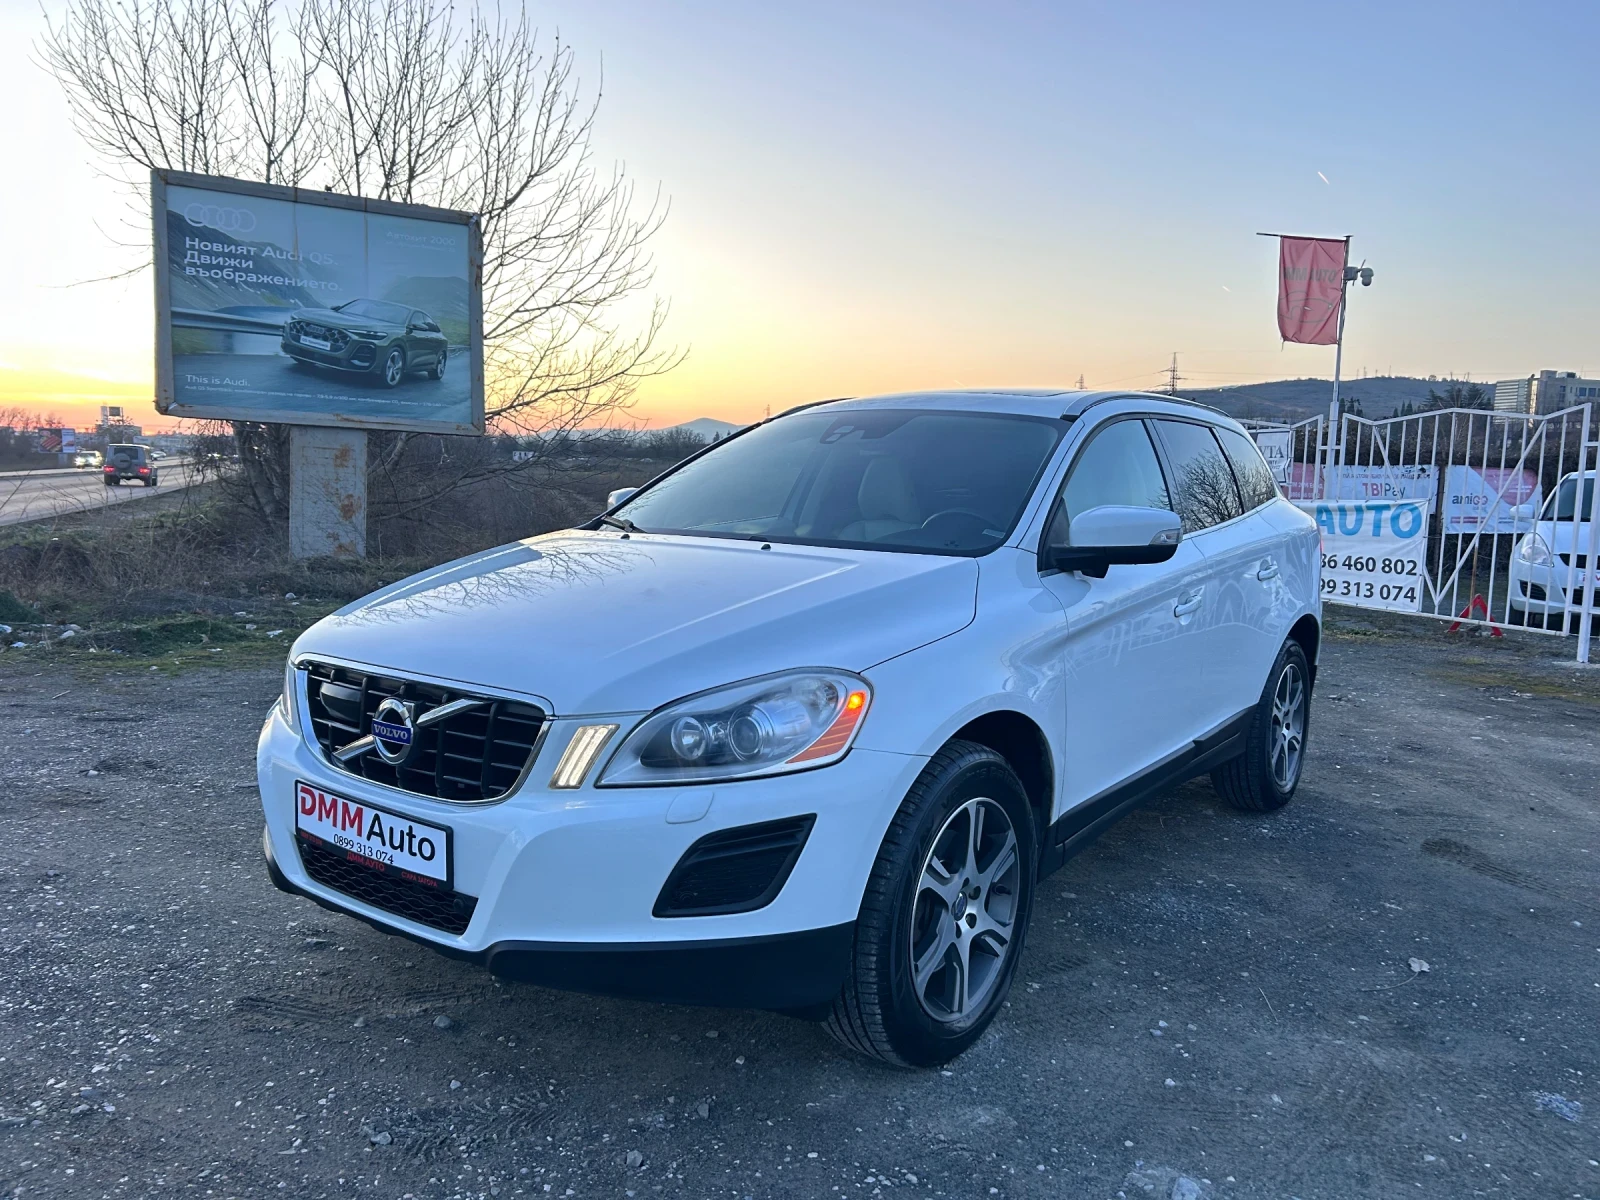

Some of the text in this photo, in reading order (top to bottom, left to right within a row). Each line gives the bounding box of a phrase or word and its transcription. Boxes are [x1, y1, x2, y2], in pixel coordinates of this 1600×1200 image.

[184, 250, 253, 269] Движи
[185, 236, 257, 255] Новият
[262, 245, 303, 261] Audi
[185, 266, 343, 291] въображението.
[185, 374, 251, 387] This is Audi.
[1316, 503, 1423, 539] AUTO
[1342, 555, 1377, 573] 460
[1381, 557, 1418, 576] 802
[1340, 580, 1374, 599] 313
[1379, 584, 1417, 603] 074
[373, 723, 408, 740] VOLVO
[333, 833, 354, 849] 0899
[356, 842, 374, 857] 313
[375, 849, 394, 865] 074
[346, 851, 385, 872] ДММ АУТО
